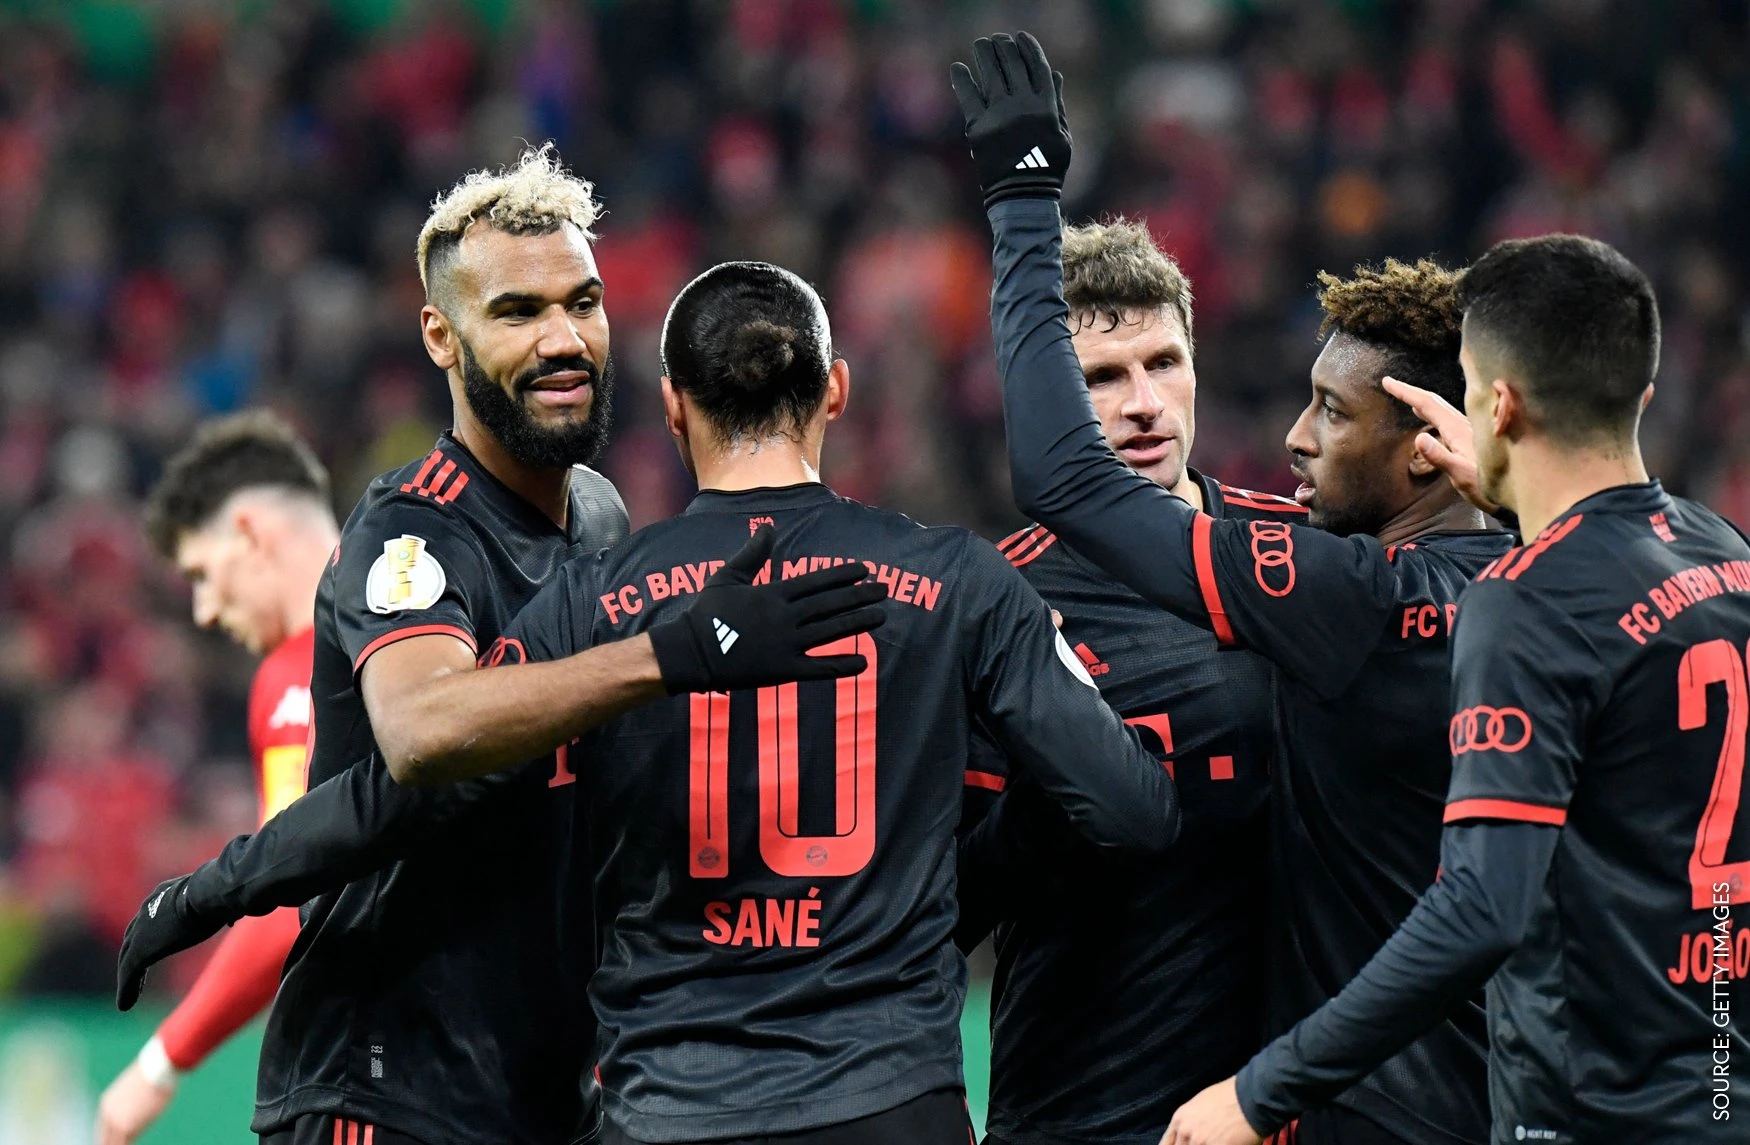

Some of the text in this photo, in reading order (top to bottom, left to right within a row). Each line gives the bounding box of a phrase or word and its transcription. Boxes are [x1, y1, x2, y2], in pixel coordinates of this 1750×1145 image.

[600, 584, 643, 625] FC
[645, 560, 772, 601] BAYN
[1401, 604, 1438, 639] FC
[1618, 602, 1661, 645] FC
[1648, 565, 1725, 620] BAYERN
[689, 631, 877, 879] 10
[1677, 637, 1750, 911] 2
[702, 886, 822, 948] SANÉ
